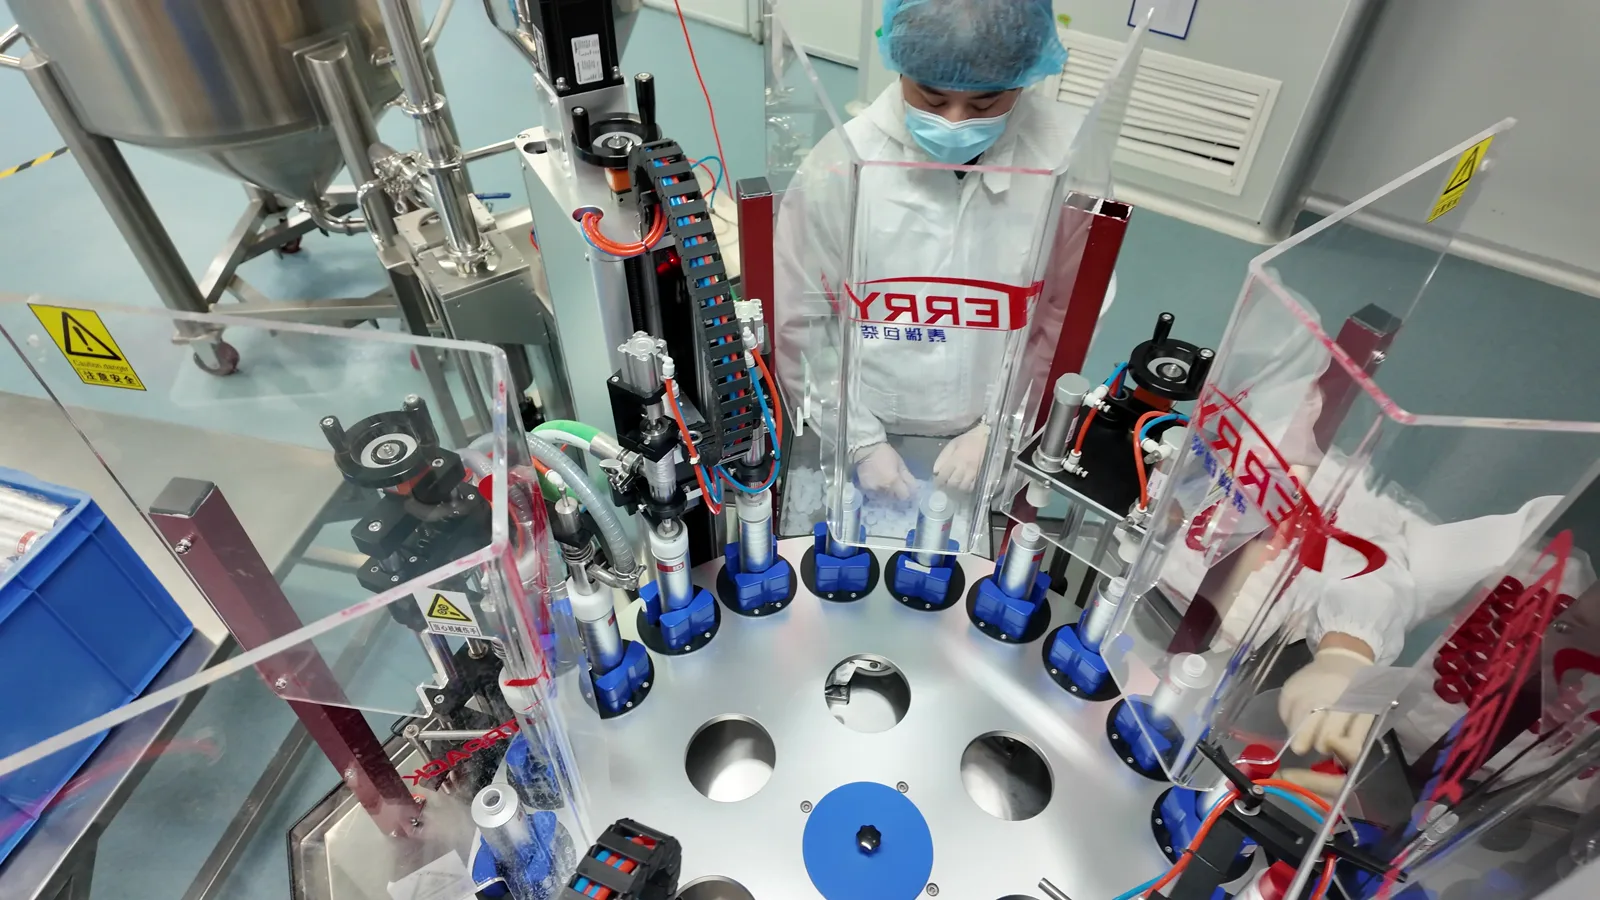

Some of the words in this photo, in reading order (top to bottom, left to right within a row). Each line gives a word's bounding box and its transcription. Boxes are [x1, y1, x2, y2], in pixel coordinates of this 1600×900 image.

[72, 359, 102, 370] Caution
[83, 370, 136, 385] 注意安全
